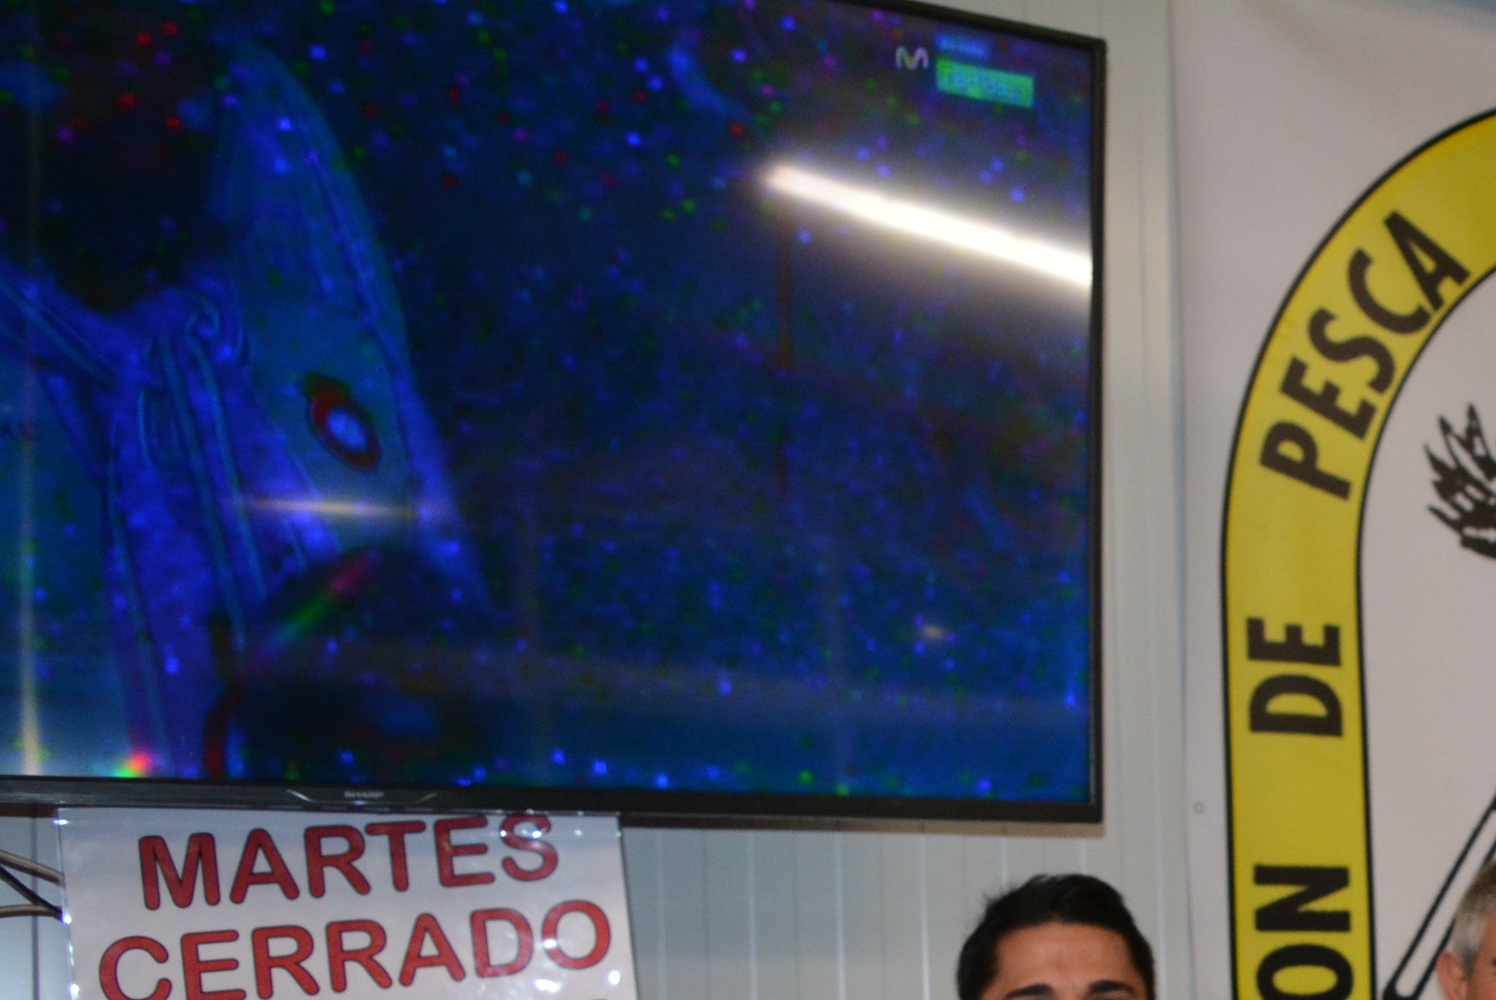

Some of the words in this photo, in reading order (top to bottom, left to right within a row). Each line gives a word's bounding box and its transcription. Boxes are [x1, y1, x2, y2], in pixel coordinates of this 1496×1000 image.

[1260, 211, 1470, 500] PESCA
[1247, 617, 1343, 738] DE
[138, 814, 559, 911] MARTES
